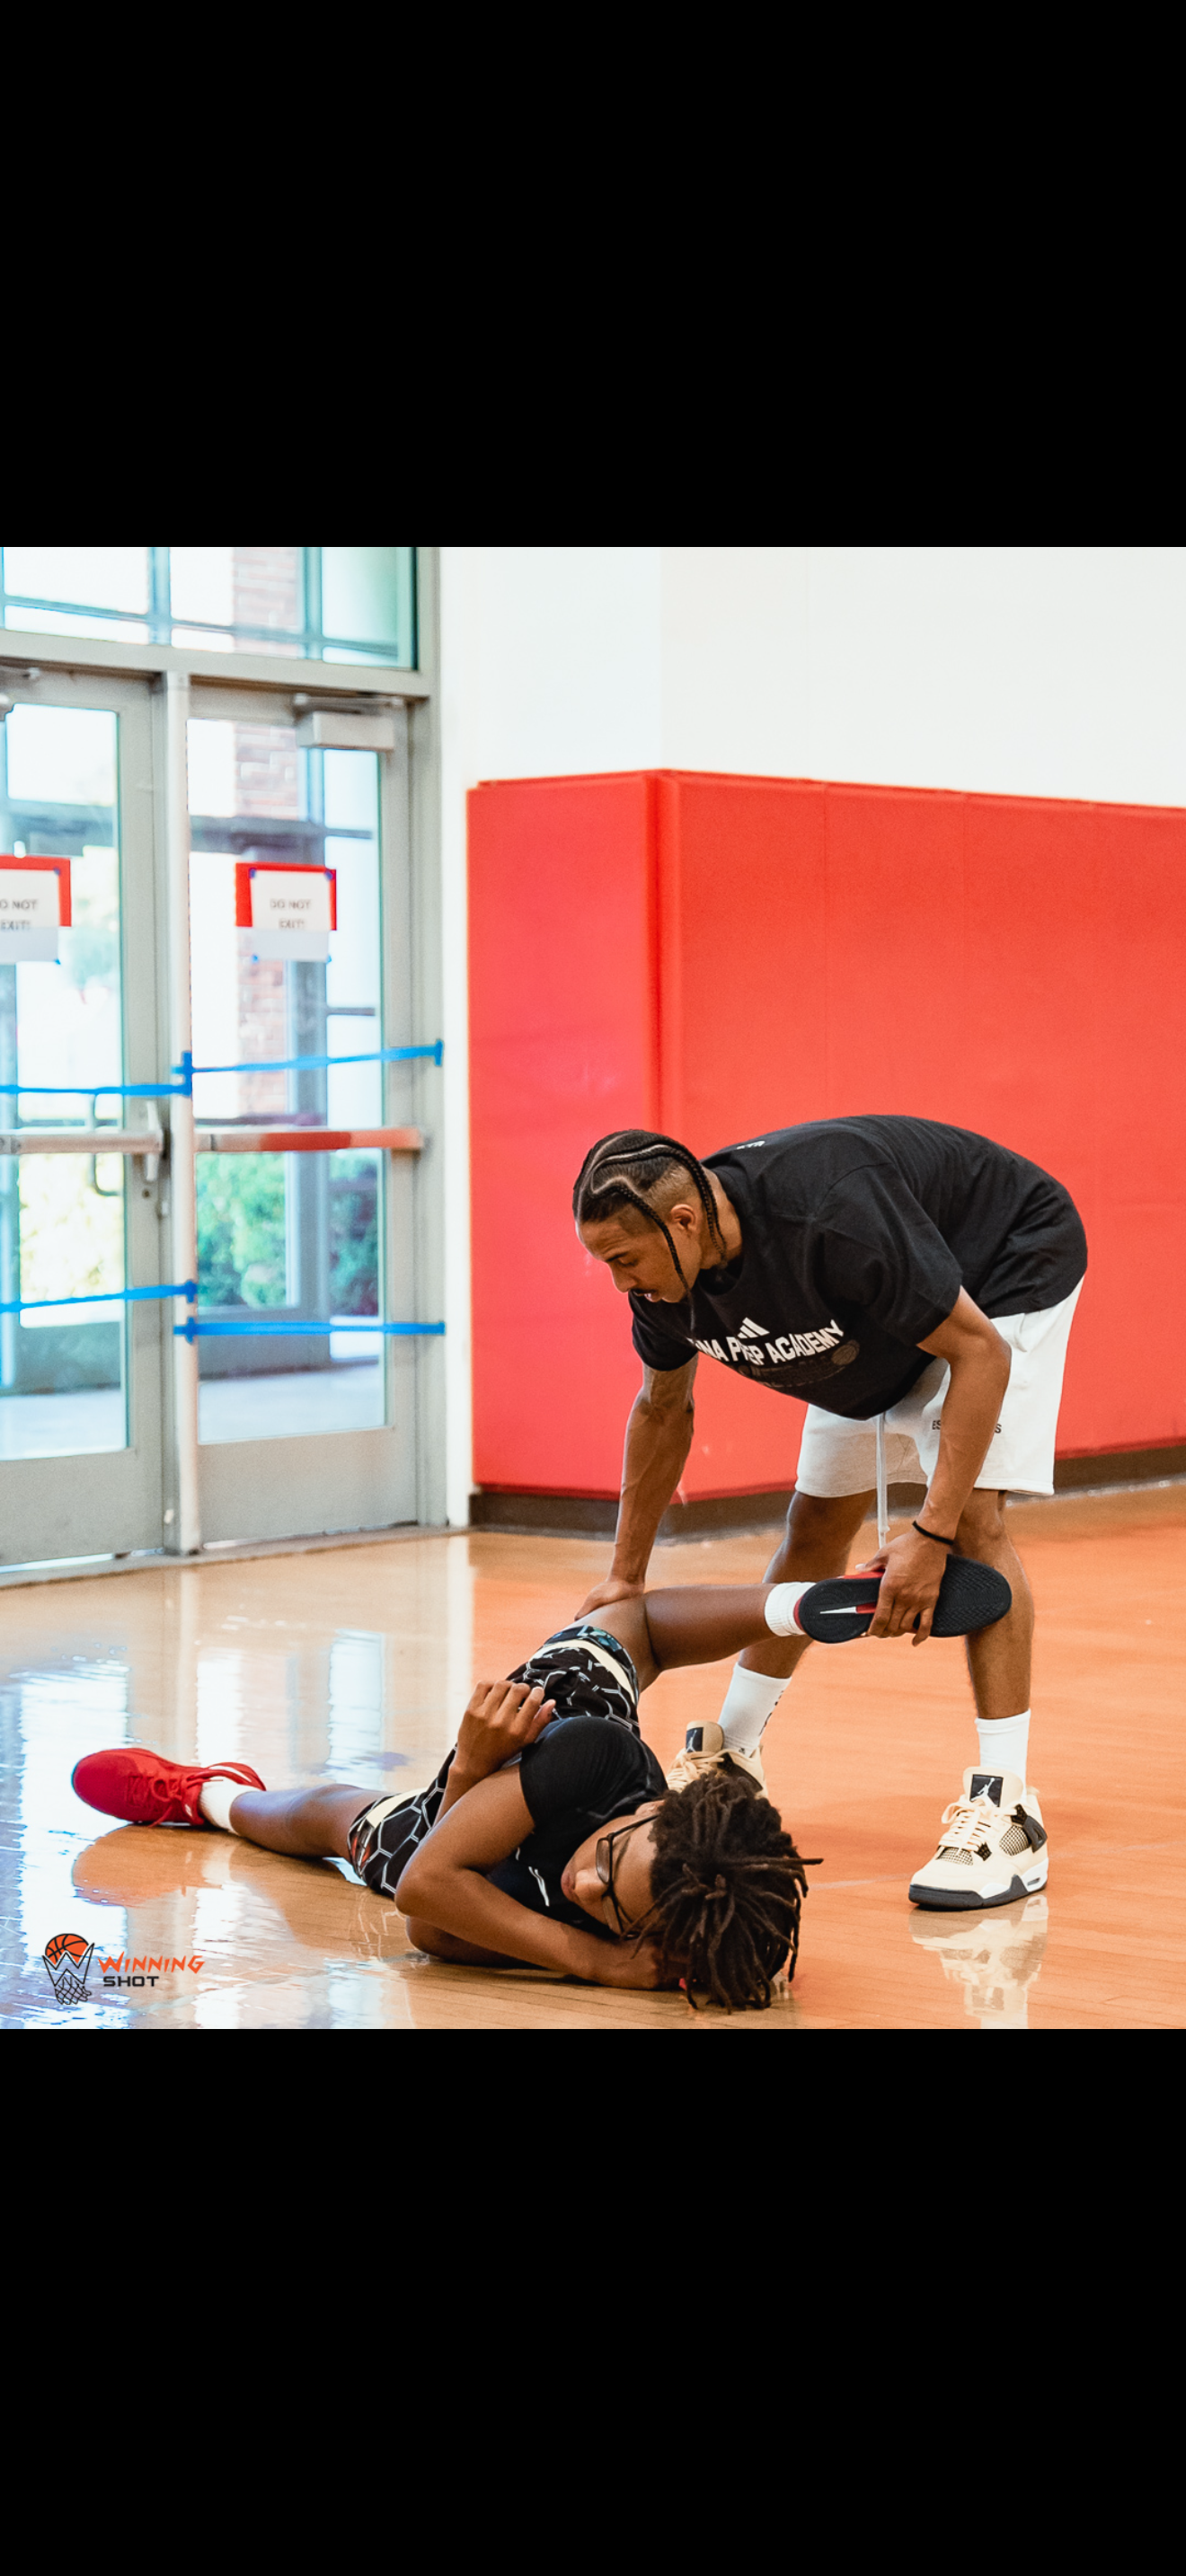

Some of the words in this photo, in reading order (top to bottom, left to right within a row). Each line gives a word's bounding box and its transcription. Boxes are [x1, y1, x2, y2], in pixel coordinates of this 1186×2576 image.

[12, 899, 38, 911] NOT
[288, 899, 312, 911] NOT
[765, 1319, 845, 1363] ACADEMY
